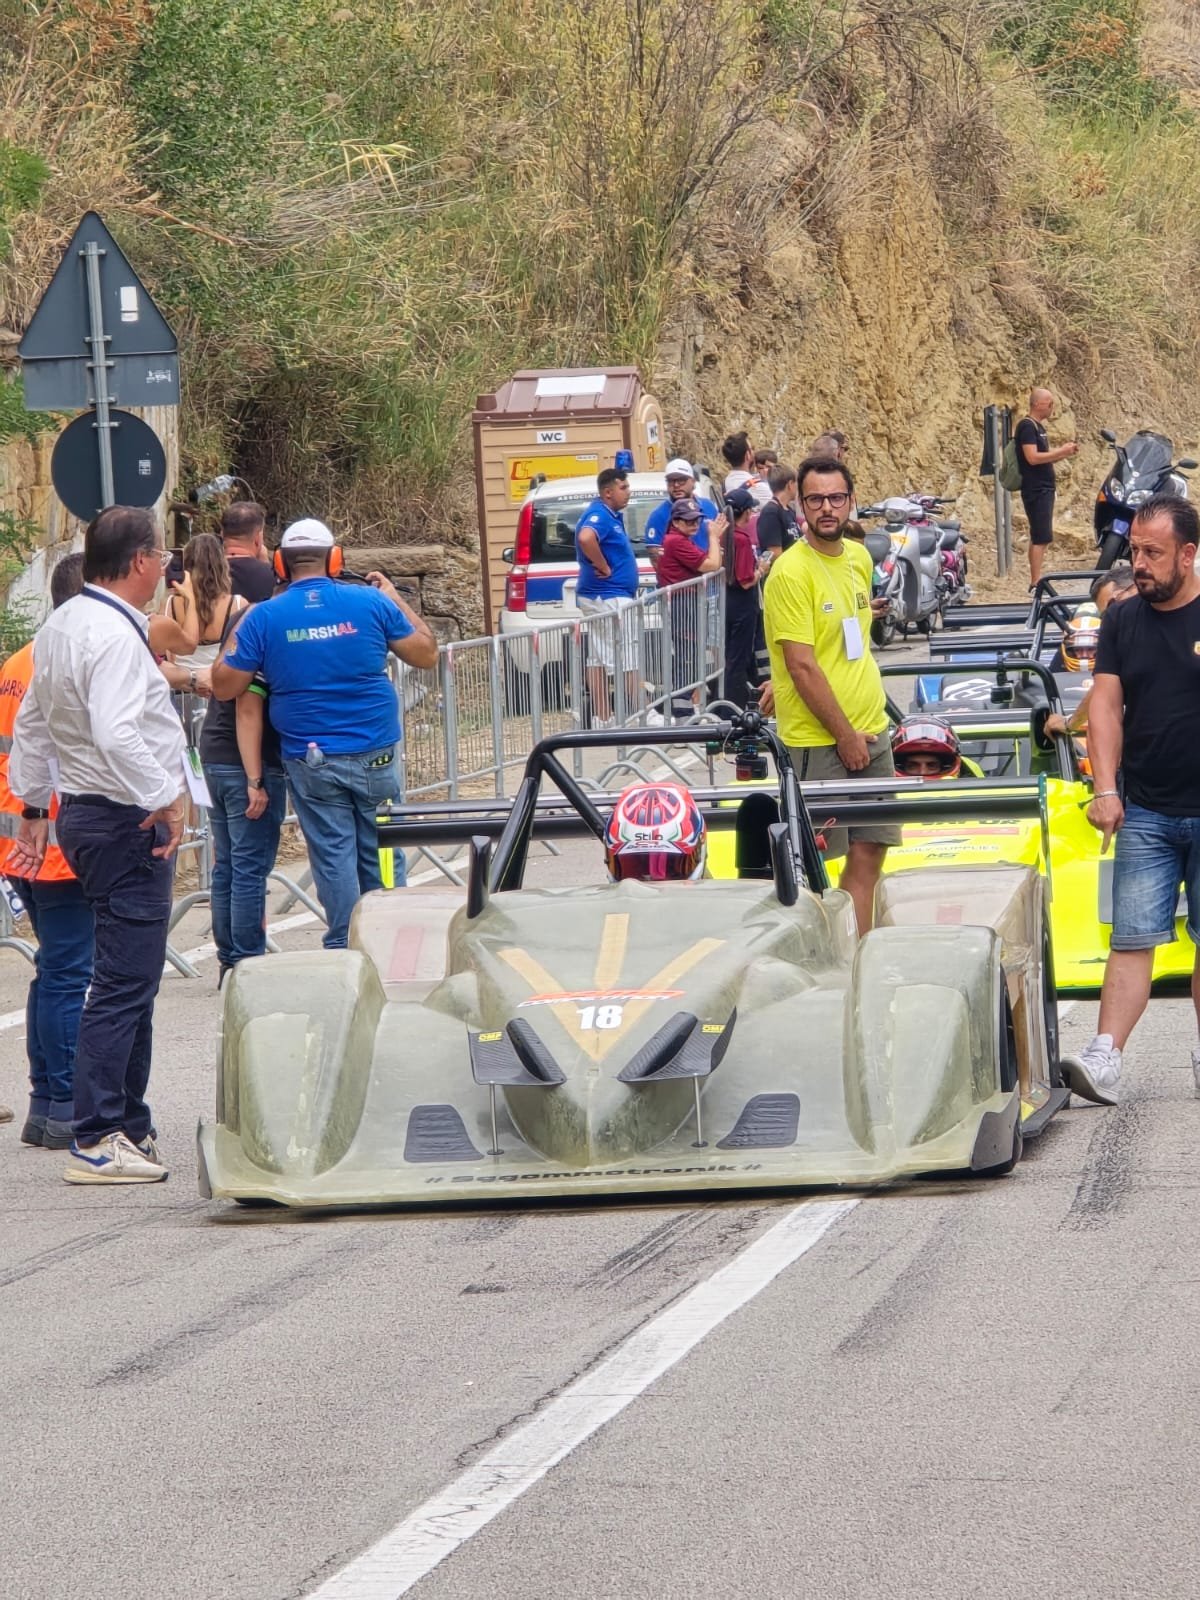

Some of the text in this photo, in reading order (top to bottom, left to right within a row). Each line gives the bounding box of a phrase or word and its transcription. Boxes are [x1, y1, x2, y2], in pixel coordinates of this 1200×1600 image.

[541, 432, 562, 442] WC
[286, 621, 358, 642] MARSHAL
[576, 1005, 623, 1030] 18
